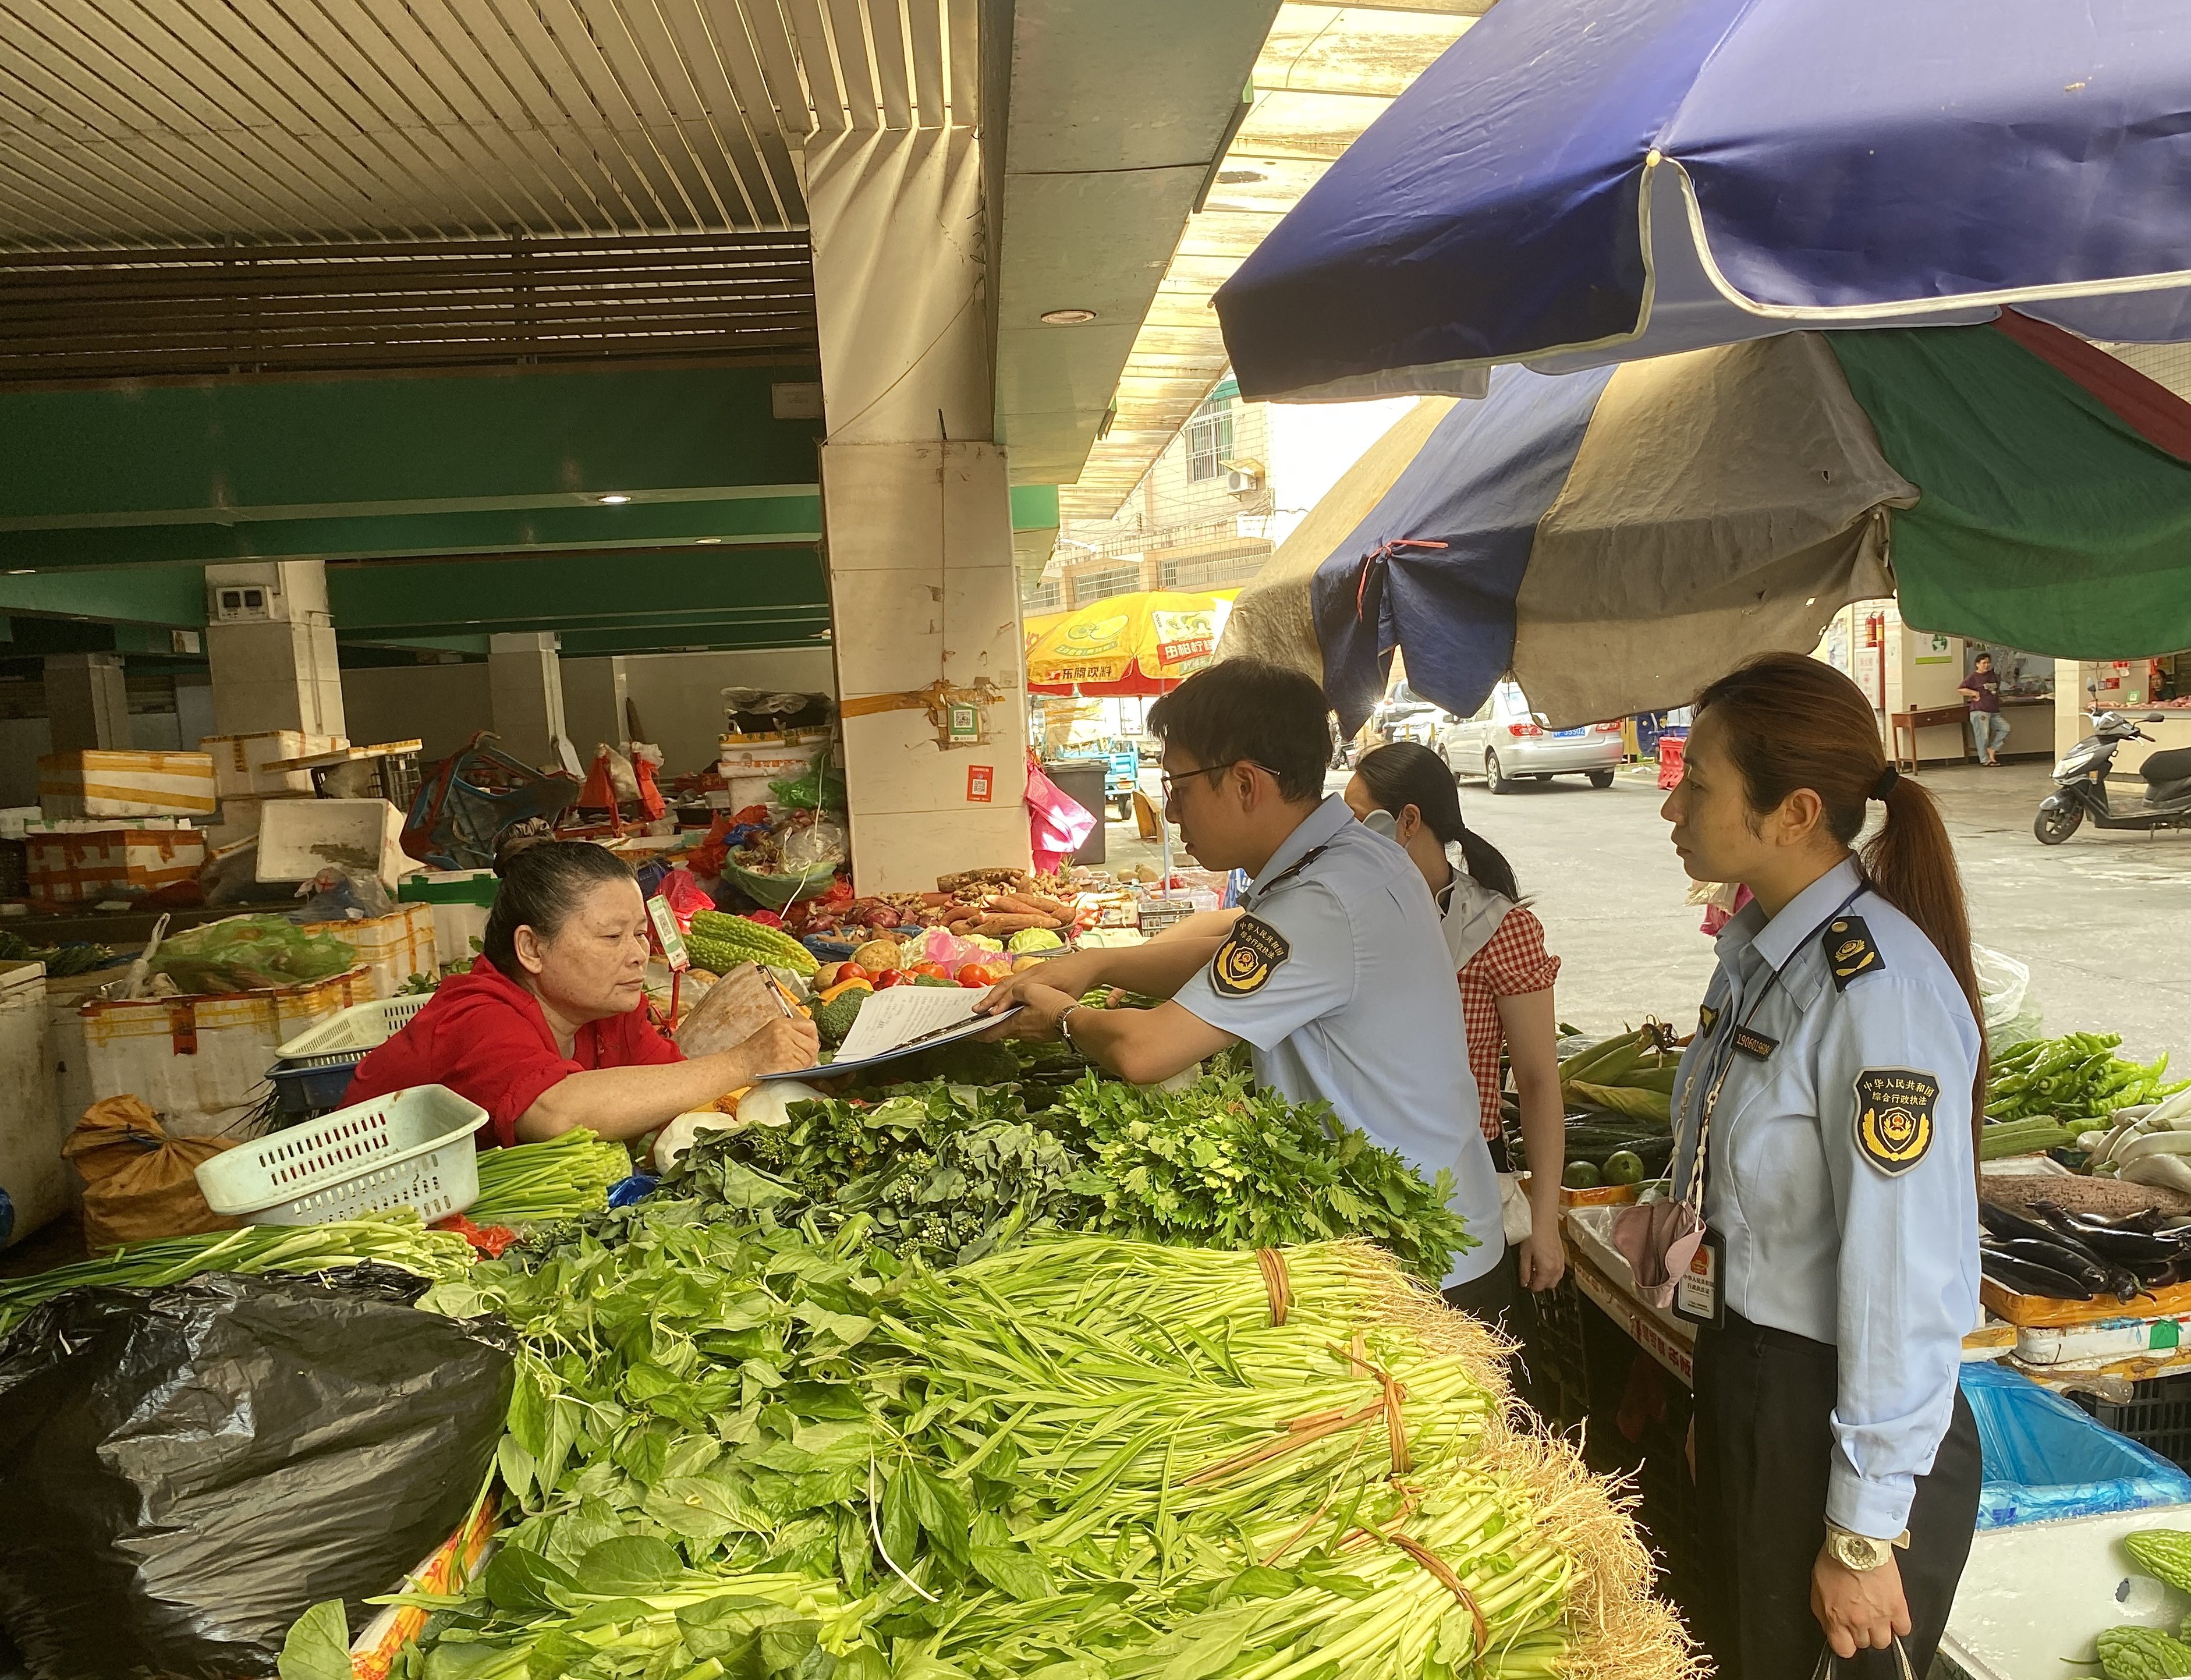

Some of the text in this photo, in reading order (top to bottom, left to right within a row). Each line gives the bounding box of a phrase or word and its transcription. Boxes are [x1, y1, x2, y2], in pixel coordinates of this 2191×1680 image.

[1062, 666, 1112, 680] 东鹏饮料
[1240, 921, 1284, 956] 中华人民共和国
[1240, 930, 1275, 960] 综合行政执法
[1863, 1078, 1935, 1098] 中华人民共和国
[1871, 1091, 1927, 1106] 综合行政执法
